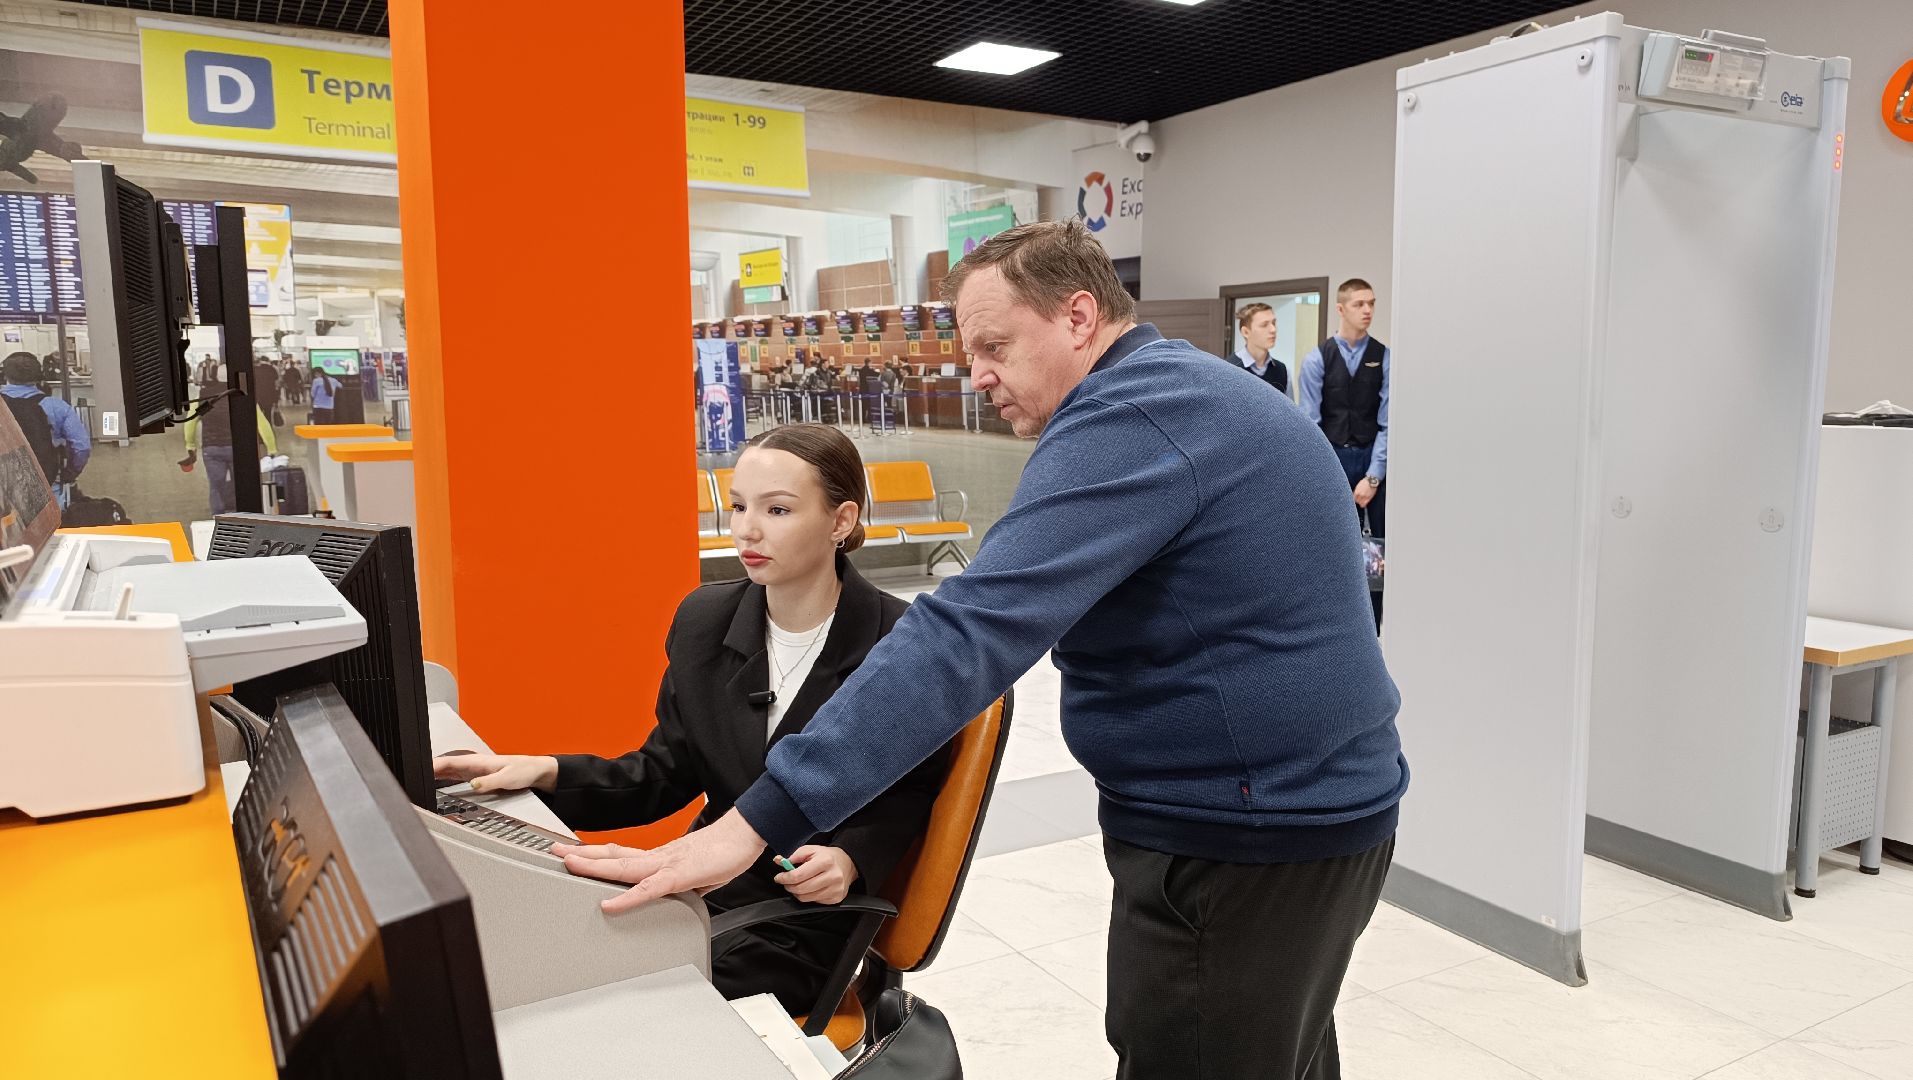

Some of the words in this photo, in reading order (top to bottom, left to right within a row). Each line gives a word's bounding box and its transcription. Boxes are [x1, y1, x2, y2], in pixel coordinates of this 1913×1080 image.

[204, 65, 256, 114] D
[302, 116, 391, 140] Terminal
[733, 112, 766, 129] 1-99
